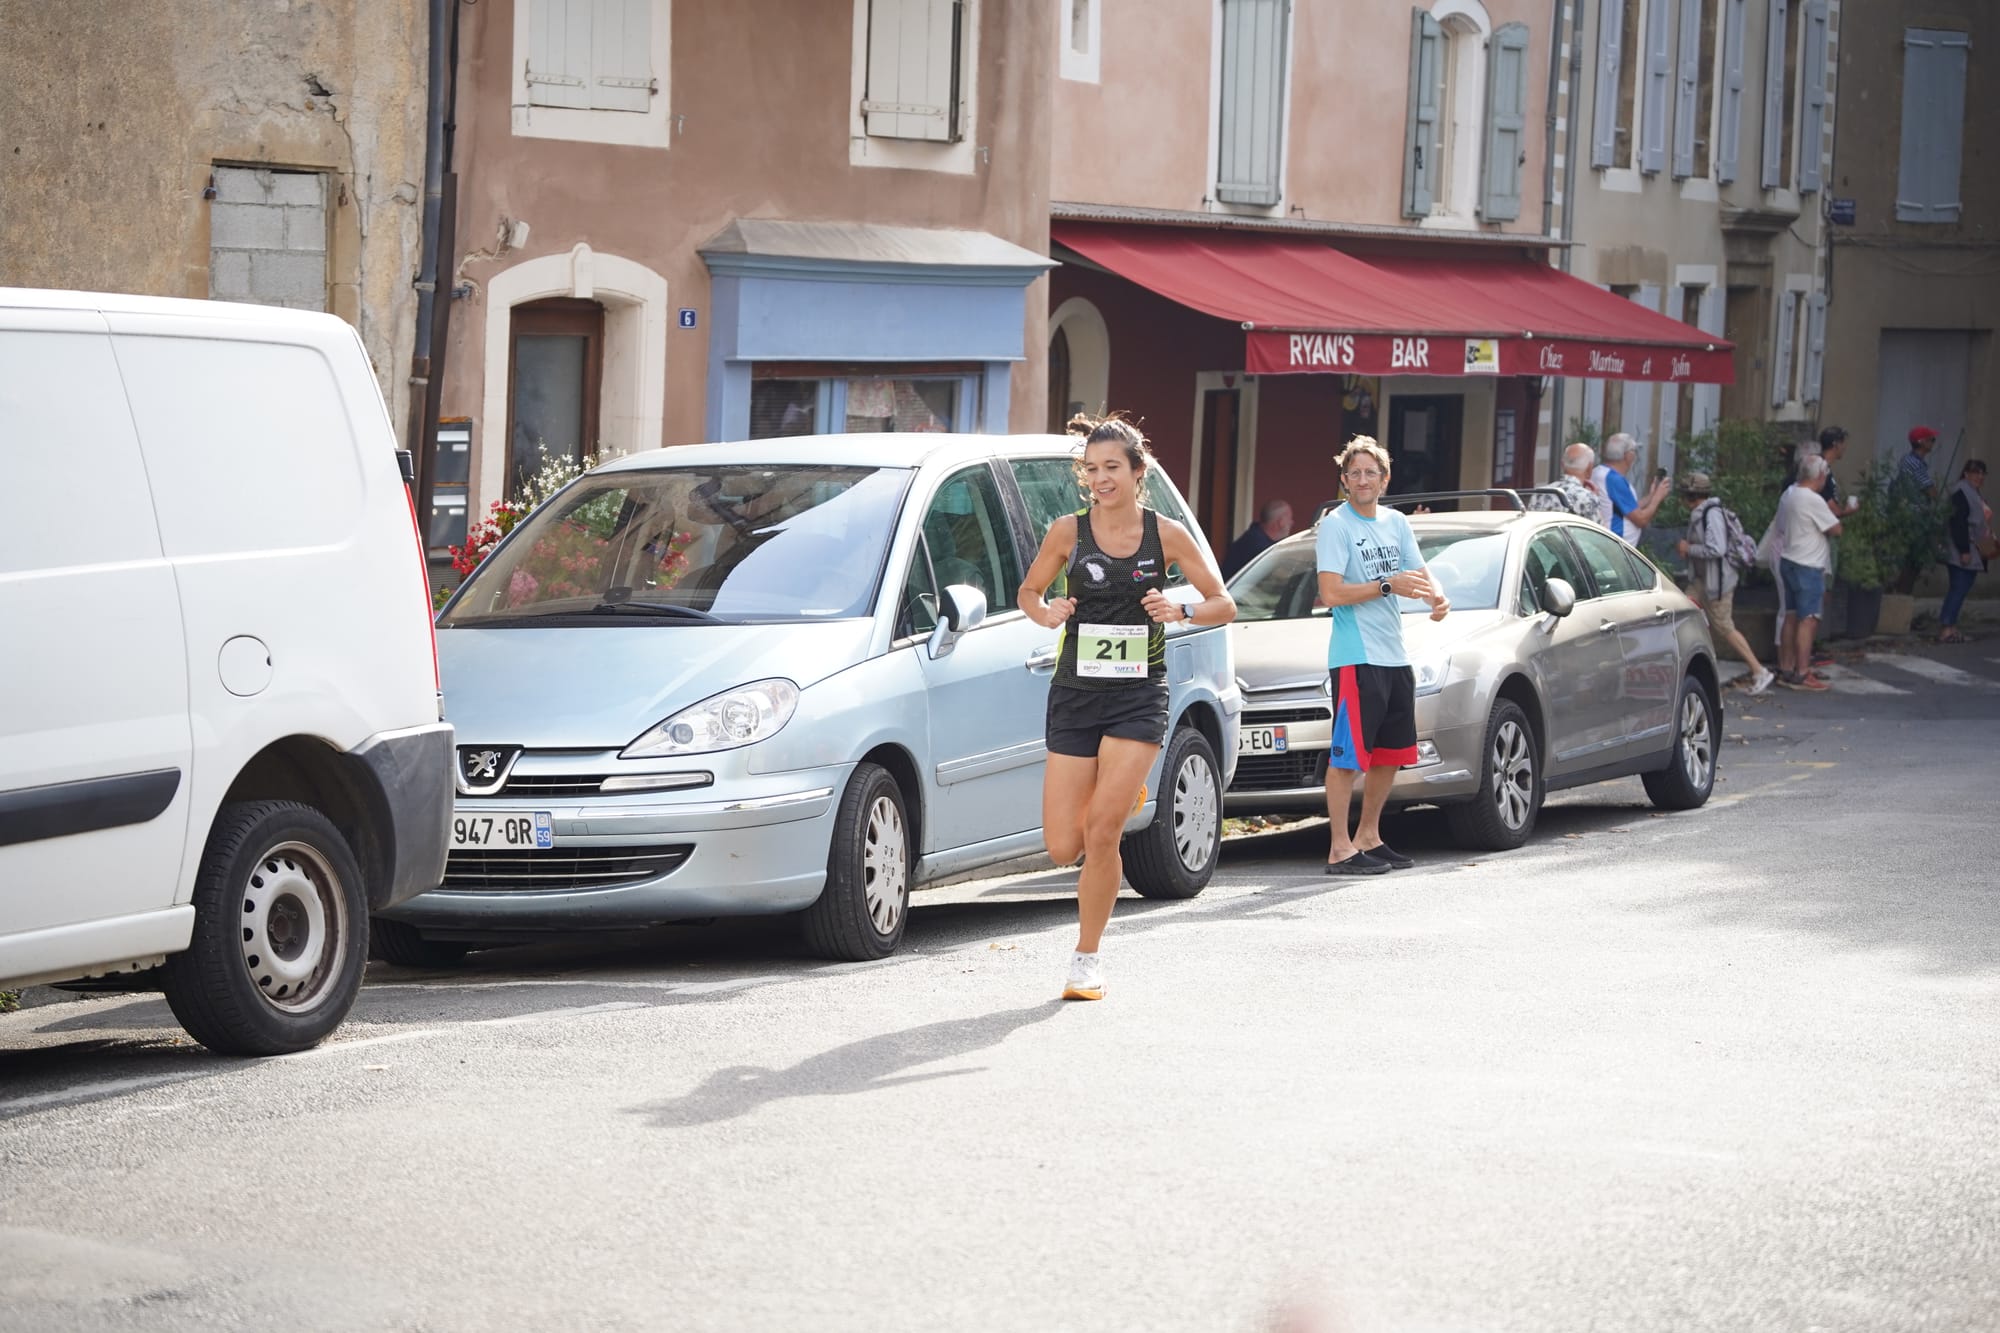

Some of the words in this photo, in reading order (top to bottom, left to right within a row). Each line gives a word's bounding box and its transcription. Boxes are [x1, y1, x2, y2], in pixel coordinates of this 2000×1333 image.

[1290, 335, 1354, 366] RYAN'S
[1391, 337, 1429, 367] BAR
[1540, 344, 1563, 369] Chez
[1588, 350, 1625, 374] Martine
[1642, 357, 1652, 375] et
[1669, 353, 1691, 380] John
[1096, 639, 1127, 660] 21
[1276, 739, 1286, 750] 48
[537, 830, 550, 843] 59
